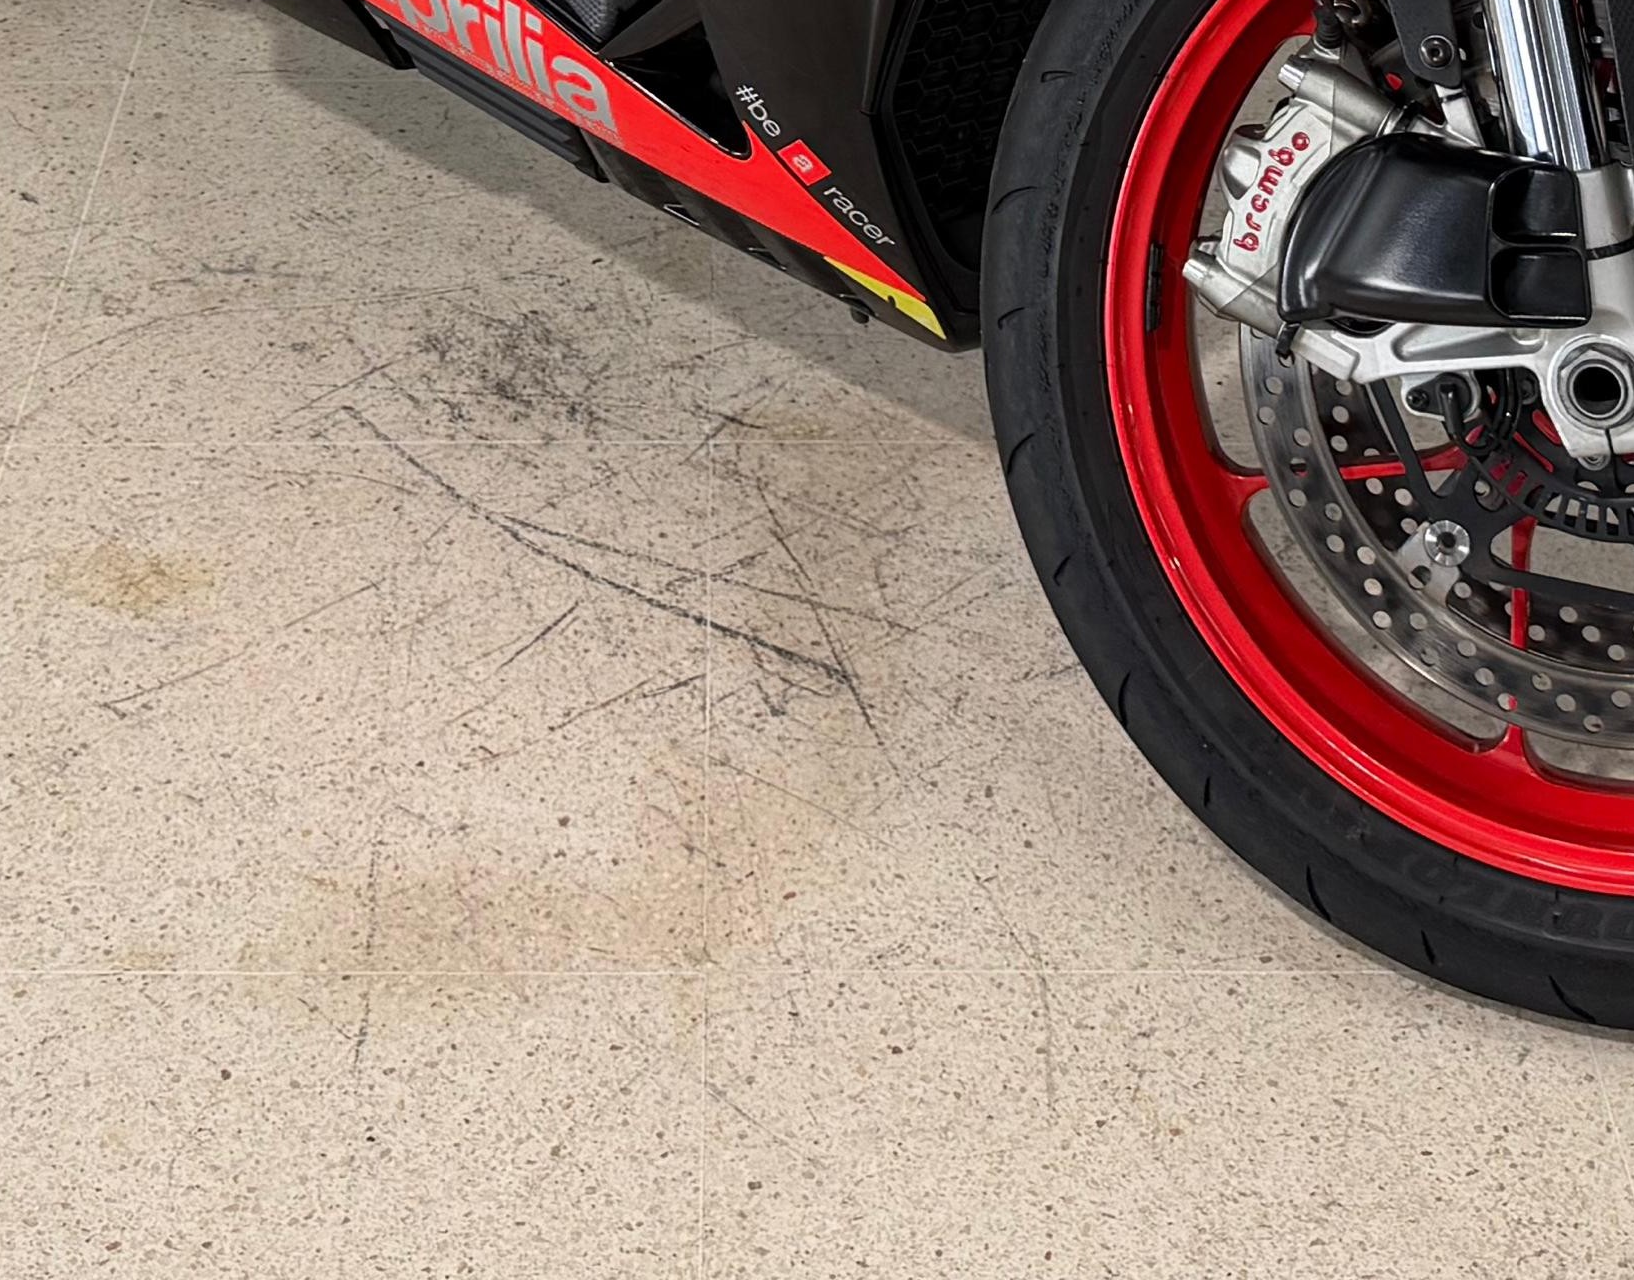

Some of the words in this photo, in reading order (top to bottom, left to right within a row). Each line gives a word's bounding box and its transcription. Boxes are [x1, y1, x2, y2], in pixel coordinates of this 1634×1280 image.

[735, 84, 781, 138] #be
[823, 187, 896, 245] racer
[1233, 131, 1310, 252] brembo
